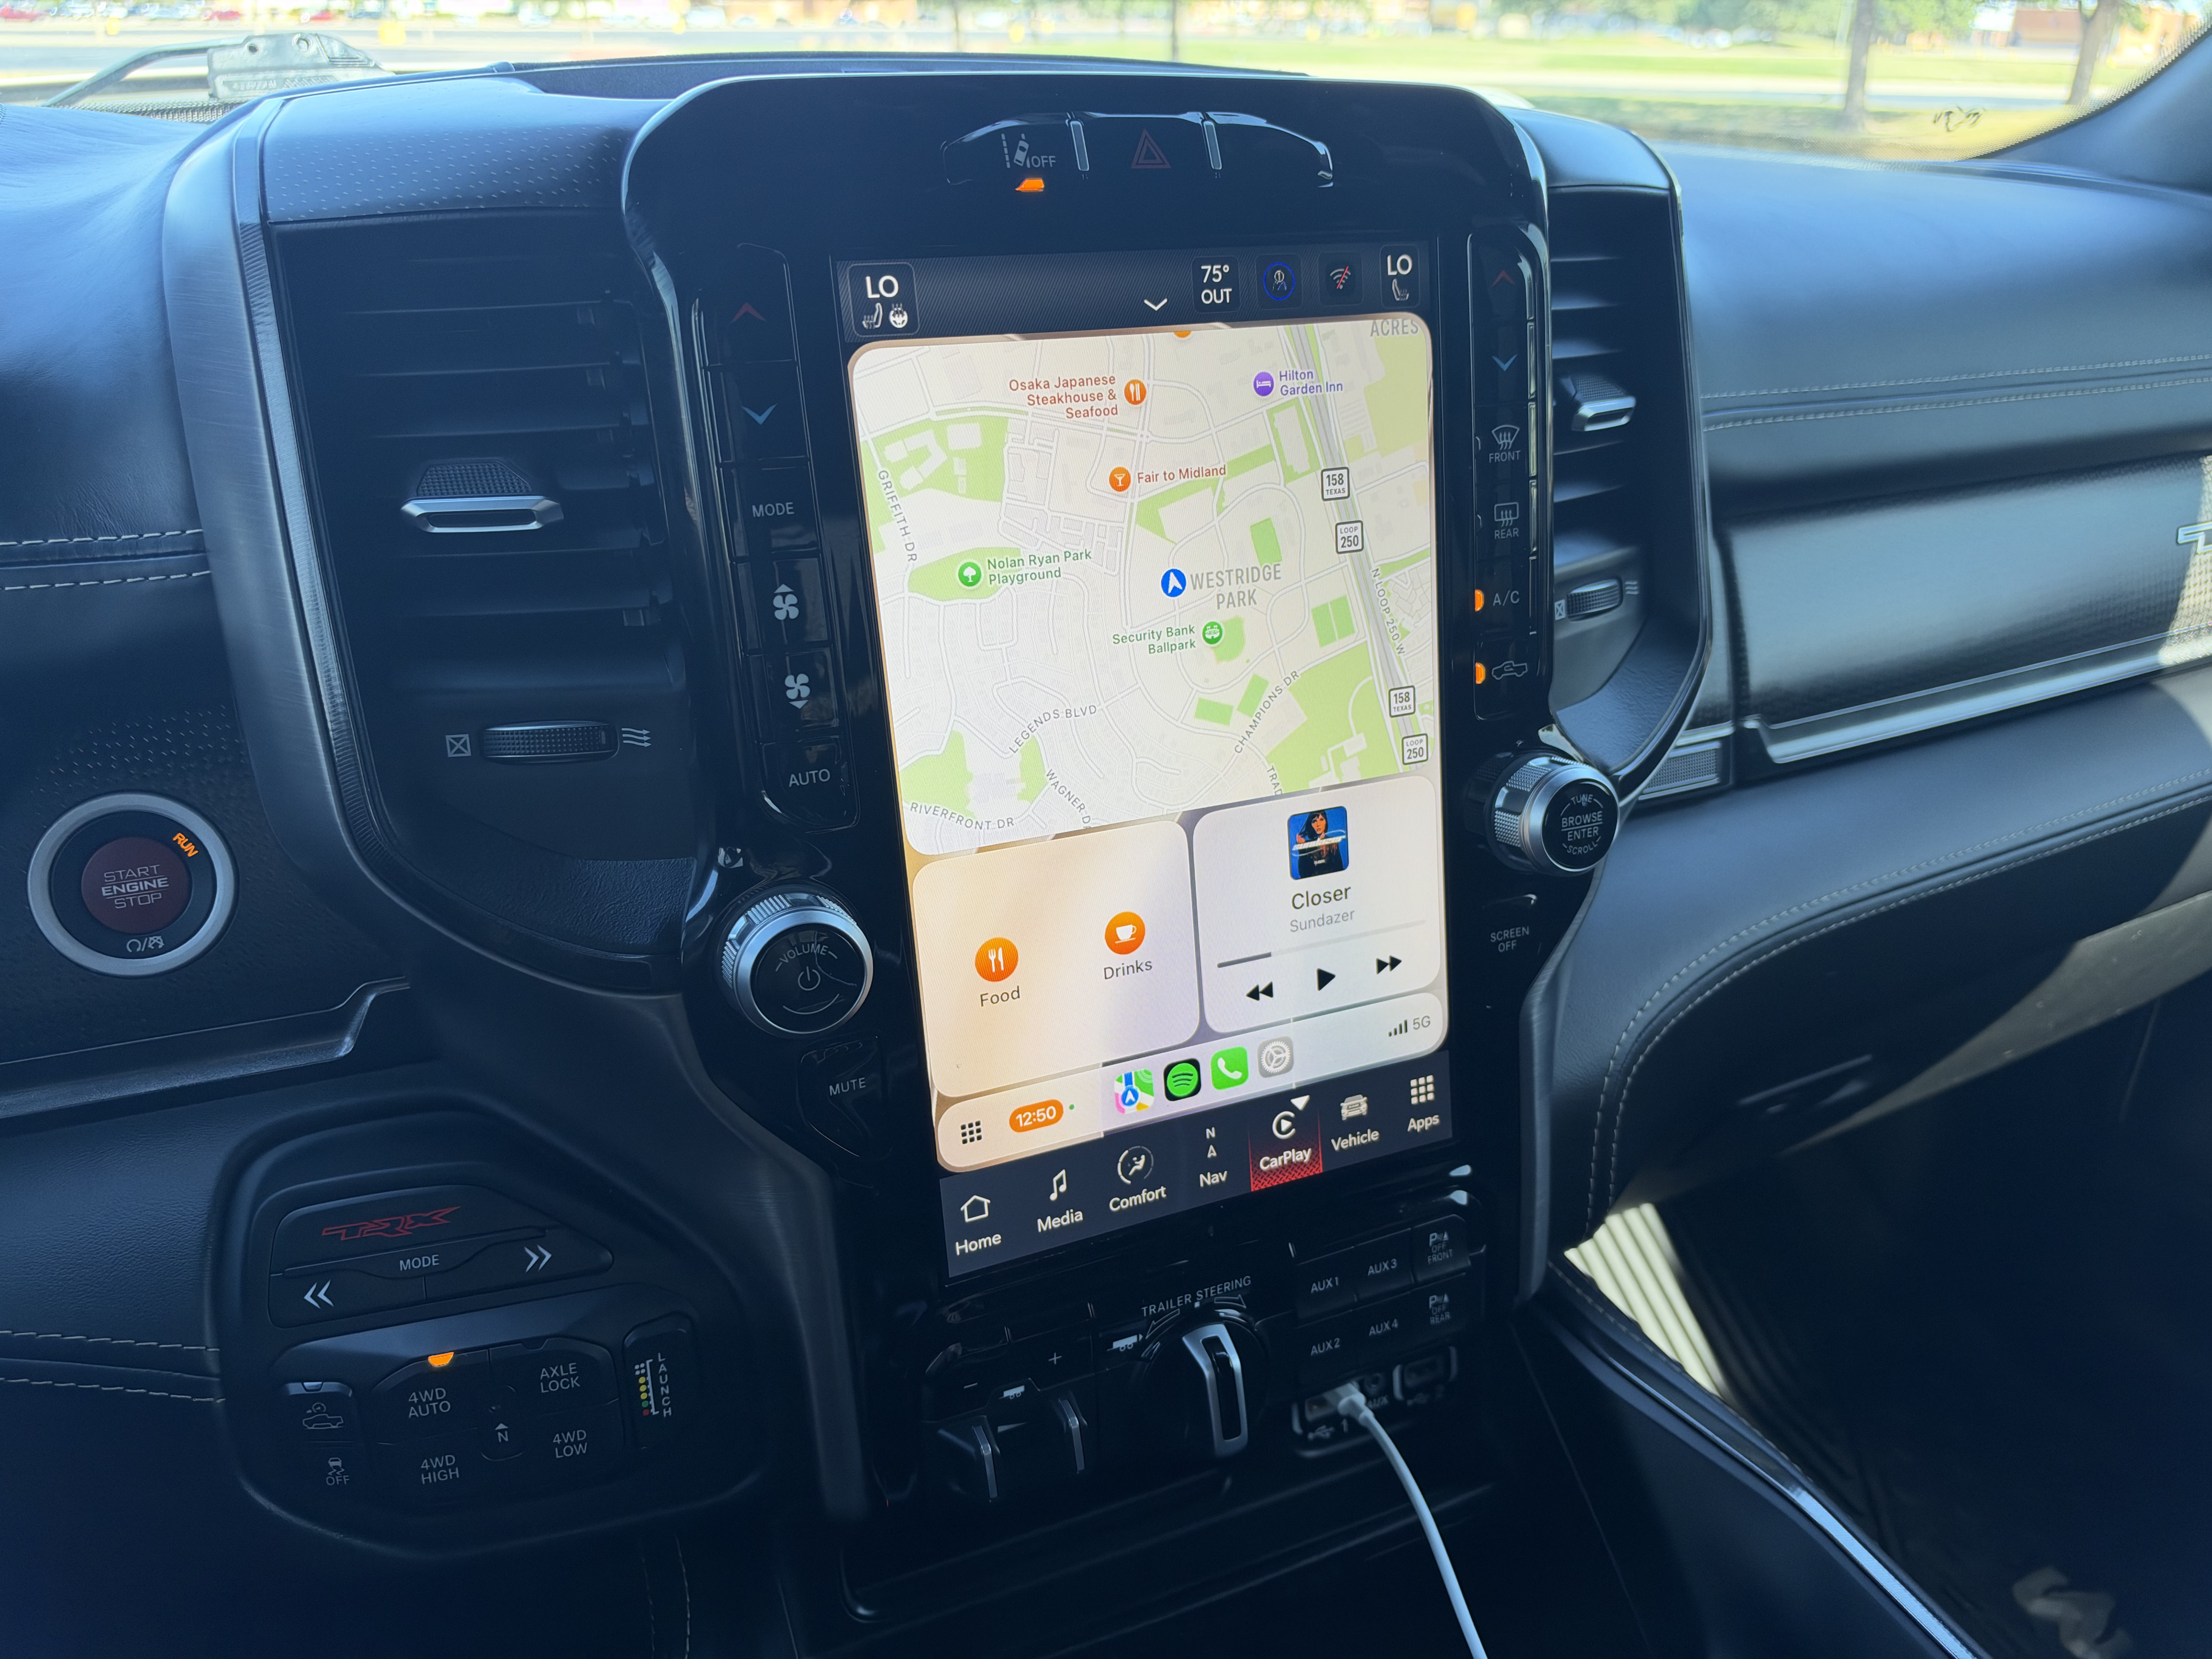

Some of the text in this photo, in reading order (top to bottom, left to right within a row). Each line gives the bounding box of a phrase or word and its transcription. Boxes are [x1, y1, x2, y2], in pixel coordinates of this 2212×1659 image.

[1031, 156, 1056, 168] OFF
[1201, 264, 1230, 283] 75°
[1387, 254, 1413, 276] LO
[865, 275, 899, 299] LO
[1201, 289, 1232, 304] OUT
[1370, 319, 1419, 337] ACRES
[1009, 374, 1116, 392] Osaka Japanese
[1279, 370, 1314, 381] Hilton
[1280, 381, 1343, 396] Garden Inn
[1027, 389, 1117, 406] Steakhouse &
[1065, 405, 1118, 419] Seafood
[1489, 450, 1521, 463] FRONT
[1137, 465, 1226, 484] Fair to Midland
[1326, 474, 1344, 488] 158
[1326, 487, 1346, 496] TEXAS
[752, 502, 795, 518] MODE
[878, 470, 917, 563] GRIFFITH DR
[1340, 526, 1358, 534] LOOP
[1494, 528, 1519, 539] REAR
[1340, 534, 1360, 549] 250
[988, 549, 1092, 570] Nolan Ryan Park
[989, 567, 1061, 587] Playground
[1190, 563, 1282, 591] WESTRIDGE
[1216, 589, 1258, 610] PARK
[1493, 590, 1520, 606] A/C
[1371, 568, 1406, 655] N LOOP 250 W
[1113, 625, 1195, 644] Security Bank
[1148, 639, 1196, 654] Ballpark
[1393, 691, 1410, 704] 158
[1234, 671, 1299, 753] CHAMPIONS DR
[1393, 704, 1412, 713] TEXAS
[1009, 705, 1097, 754] LEGENDS BLVD
[1406, 738, 1424, 747] LOOP
[1407, 747, 1424, 760] 250
[788, 768, 831, 787] AUTO
[1046, 769, 1085, 813] WAGNER
[1571, 794, 1594, 805] TUNE
[910, 802, 1014, 830] RIVERFRONT DR
[1561, 811, 1603, 828] BROWSE
[1568, 826, 1599, 842] ENTER
[172, 833, 199, 857] RUN
[1566, 841, 1598, 855] SCROLL
[104, 865, 160, 882] START
[101, 877, 169, 896] ENGINE
[114, 892, 162, 909] STOP
[1291, 886, 1351, 910] Closer
[1290, 910, 1355, 933] Sundazer
[1491, 926, 1529, 942] SCREEN
[779, 943, 829, 963] VOLUME
[1498, 939, 1517, 952] OFF
[980, 959, 1152, 1007] Food Drinks
[1413, 1015, 1431, 1030] 5G
[829, 1077, 866, 1096] MUTE
[1015, 1105, 1057, 1127] 12:50
[1407, 1114, 1439, 1133] Apps
[1331, 1128, 1380, 1151] Vehicle
[1259, 1147, 1312, 1171] CarPlay
[1199, 1170, 1228, 1187] Nav
[1109, 1185, 1166, 1211] Comfort
[1037, 1209, 1084, 1233] Media
[955, 1233, 1002, 1256] Home
[1431, 1242, 1446, 1254] OFF
[400, 1254, 440, 1271] MODE
[1428, 1249, 1453, 1265] FRONT
[1141, 1276, 1251, 1317] TRAILER STEERING
[1430, 1311, 1451, 1325] REAR
[1431, 1304, 1446, 1315] OFF
[540, 1362, 577, 1380] AXLE
[540, 1376, 580, 1393] LOCK
[658, 1353, 672, 1417] LAUNCH
[408, 1388, 447, 1403] 4WD
[408, 1401, 451, 1419] AUTO
[498, 1431, 509, 1443] N
[553, 1430, 587, 1444] 4WD
[555, 1442, 587, 1458] LOW
[421, 1455, 455, 1470] 4WD
[326, 1475, 350, 1486] OFF
[422, 1467, 460, 1485] HIGH
